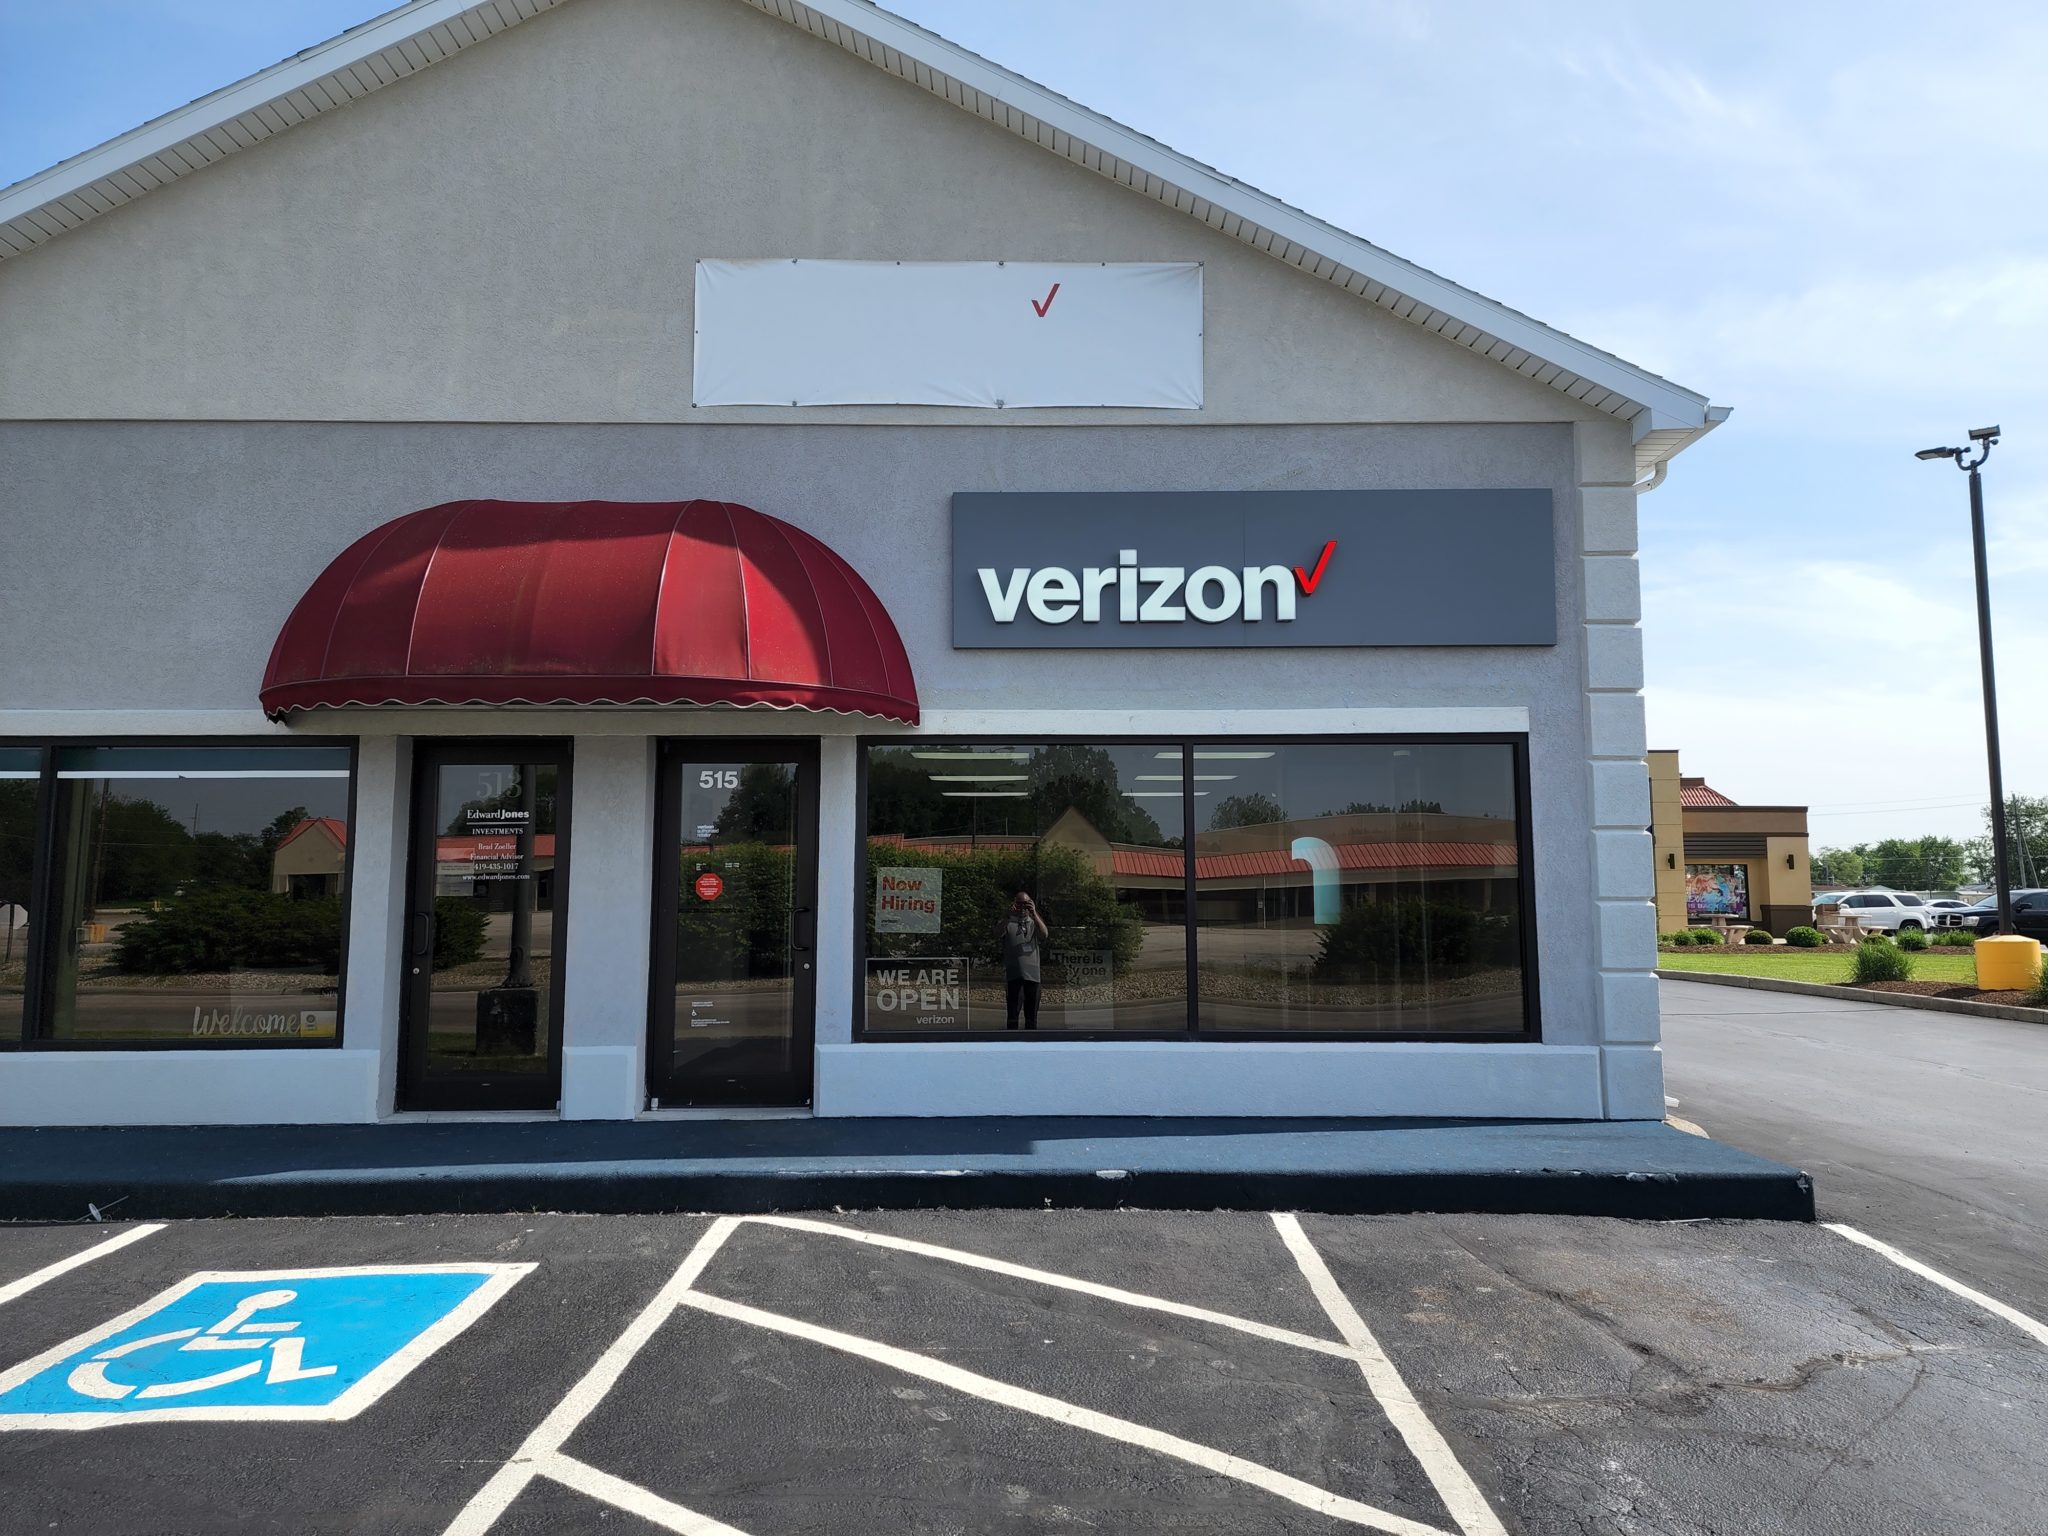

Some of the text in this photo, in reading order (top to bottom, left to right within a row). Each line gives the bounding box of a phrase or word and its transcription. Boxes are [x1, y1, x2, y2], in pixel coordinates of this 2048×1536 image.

[977, 548, 1296, 625] verizon
[476, 771, 522, 799] 513
[699, 770, 738, 790] 515
[472, 827, 524, 835] INVESTMENTS
[462, 873, 530, 882] www.edwardjones.com
[882, 876, 923, 892] Now
[881, 895, 935, 914] Hiring
[1052, 952, 1090, 964] There
[876, 968, 959, 986] WE ARE
[1082, 967, 1106, 976] one
[876, 988, 960, 1012] OPEN
[915, 1014, 955, 1025] verizon
